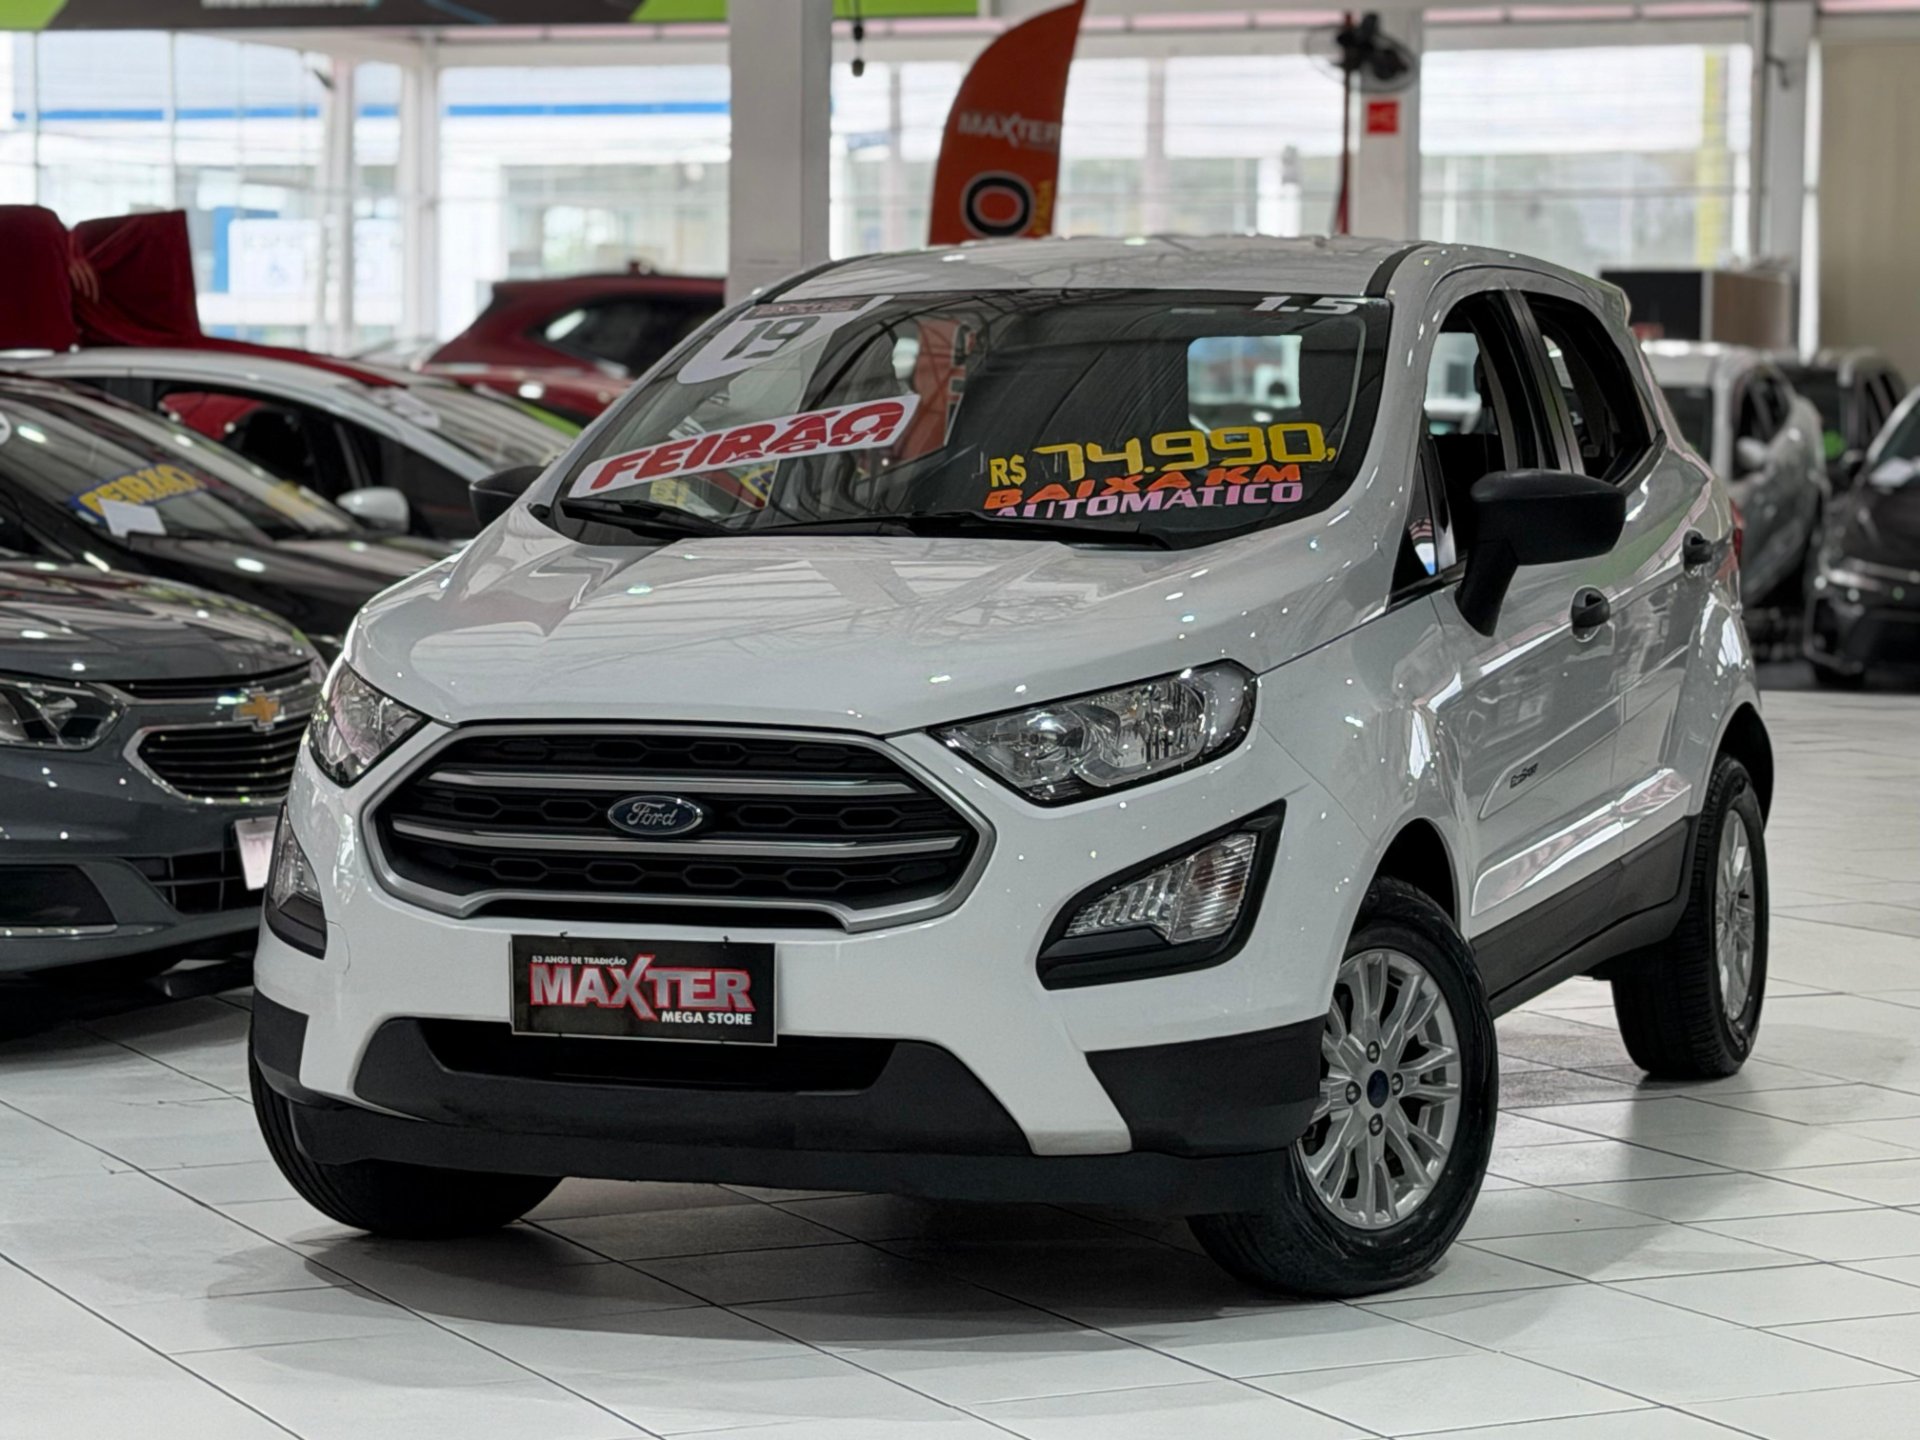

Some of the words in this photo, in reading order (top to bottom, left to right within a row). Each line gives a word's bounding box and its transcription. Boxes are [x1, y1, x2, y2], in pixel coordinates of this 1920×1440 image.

[1253, 295, 1368, 315] 1.5
[721, 315, 821, 361] 19
[590, 401, 905, 490] FEIRÃO
[984, 471, 1192, 510] BAIXA
[1205, 464, 1301, 486] KM
[989, 455, 1027, 487] R$
[626, 801, 679, 826] Ford
[544, 956, 569, 964] ANOS
[571, 956, 582, 964] DE
[530, 954, 756, 1022] MAXTER
[661, 1011, 704, 1024] MEGA
[707, 1013, 753, 1026] STORE
